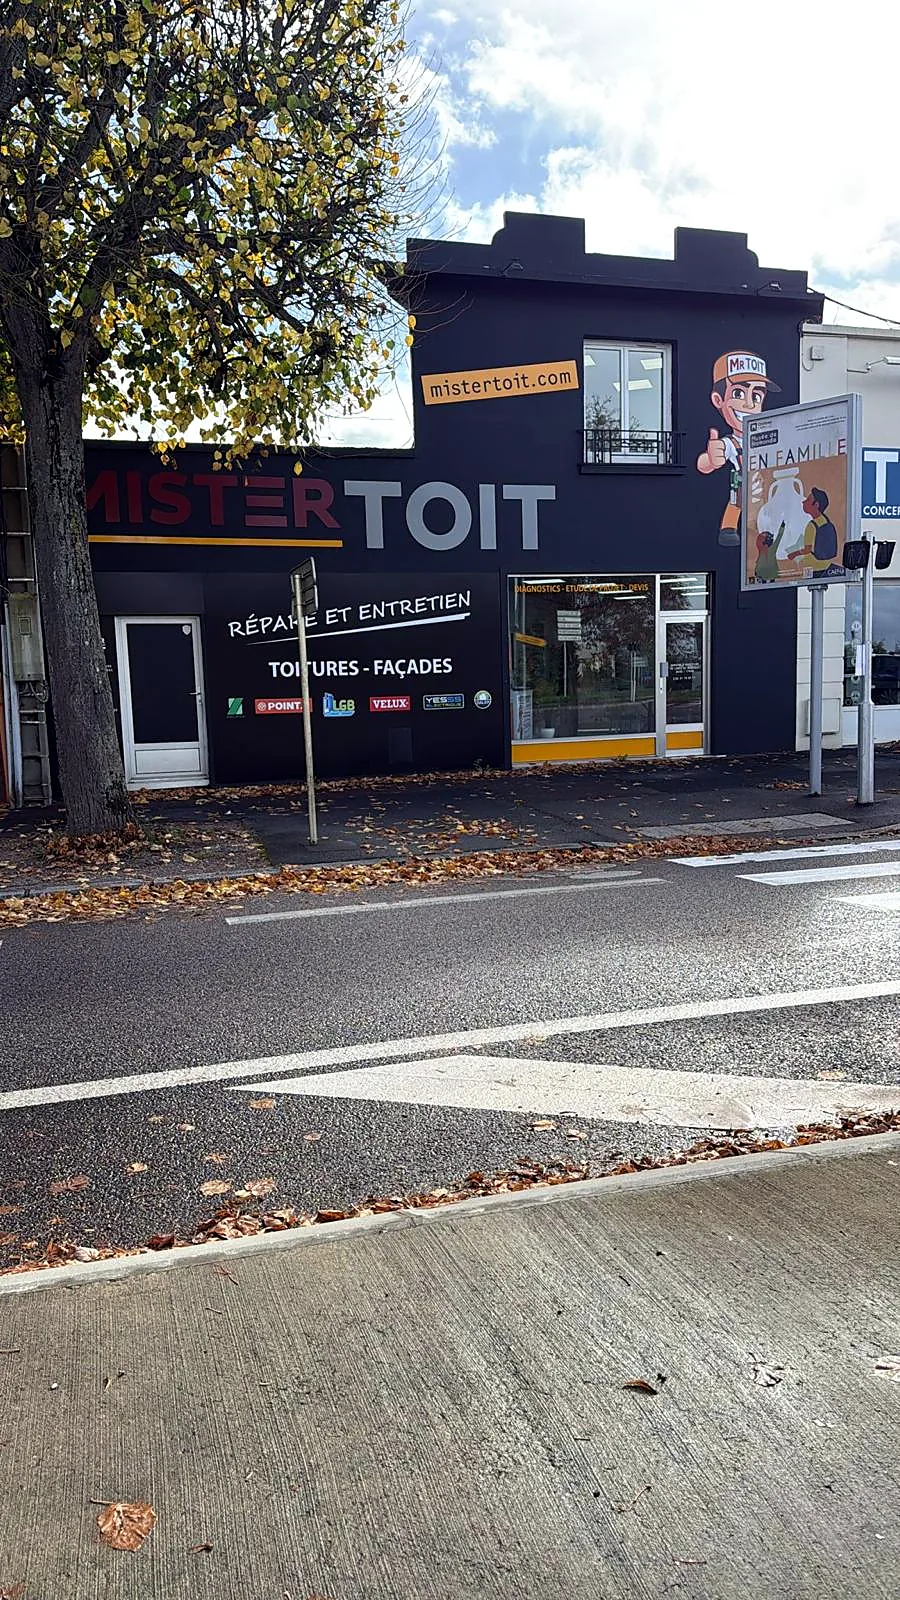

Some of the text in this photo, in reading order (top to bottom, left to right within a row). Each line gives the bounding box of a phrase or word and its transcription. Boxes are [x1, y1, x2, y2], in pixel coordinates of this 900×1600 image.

[745, 357, 765, 374] TOIT
[430, 371, 572, 398] mistertoit.com
[750, 439, 847, 470] EN FAMILLE
[86, 470, 556, 550] MISTER TOIT
[514, 584, 561, 593] DIAGNOSTICS
[628, 583, 649, 592] DEVIS
[325, 607, 352, 625] ET
[359, 590, 471, 621] ENTRETIEN
[373, 658, 453, 679] FAÇADES
[333, 699, 356, 711] LGB
[372, 698, 407, 709] VELUX
